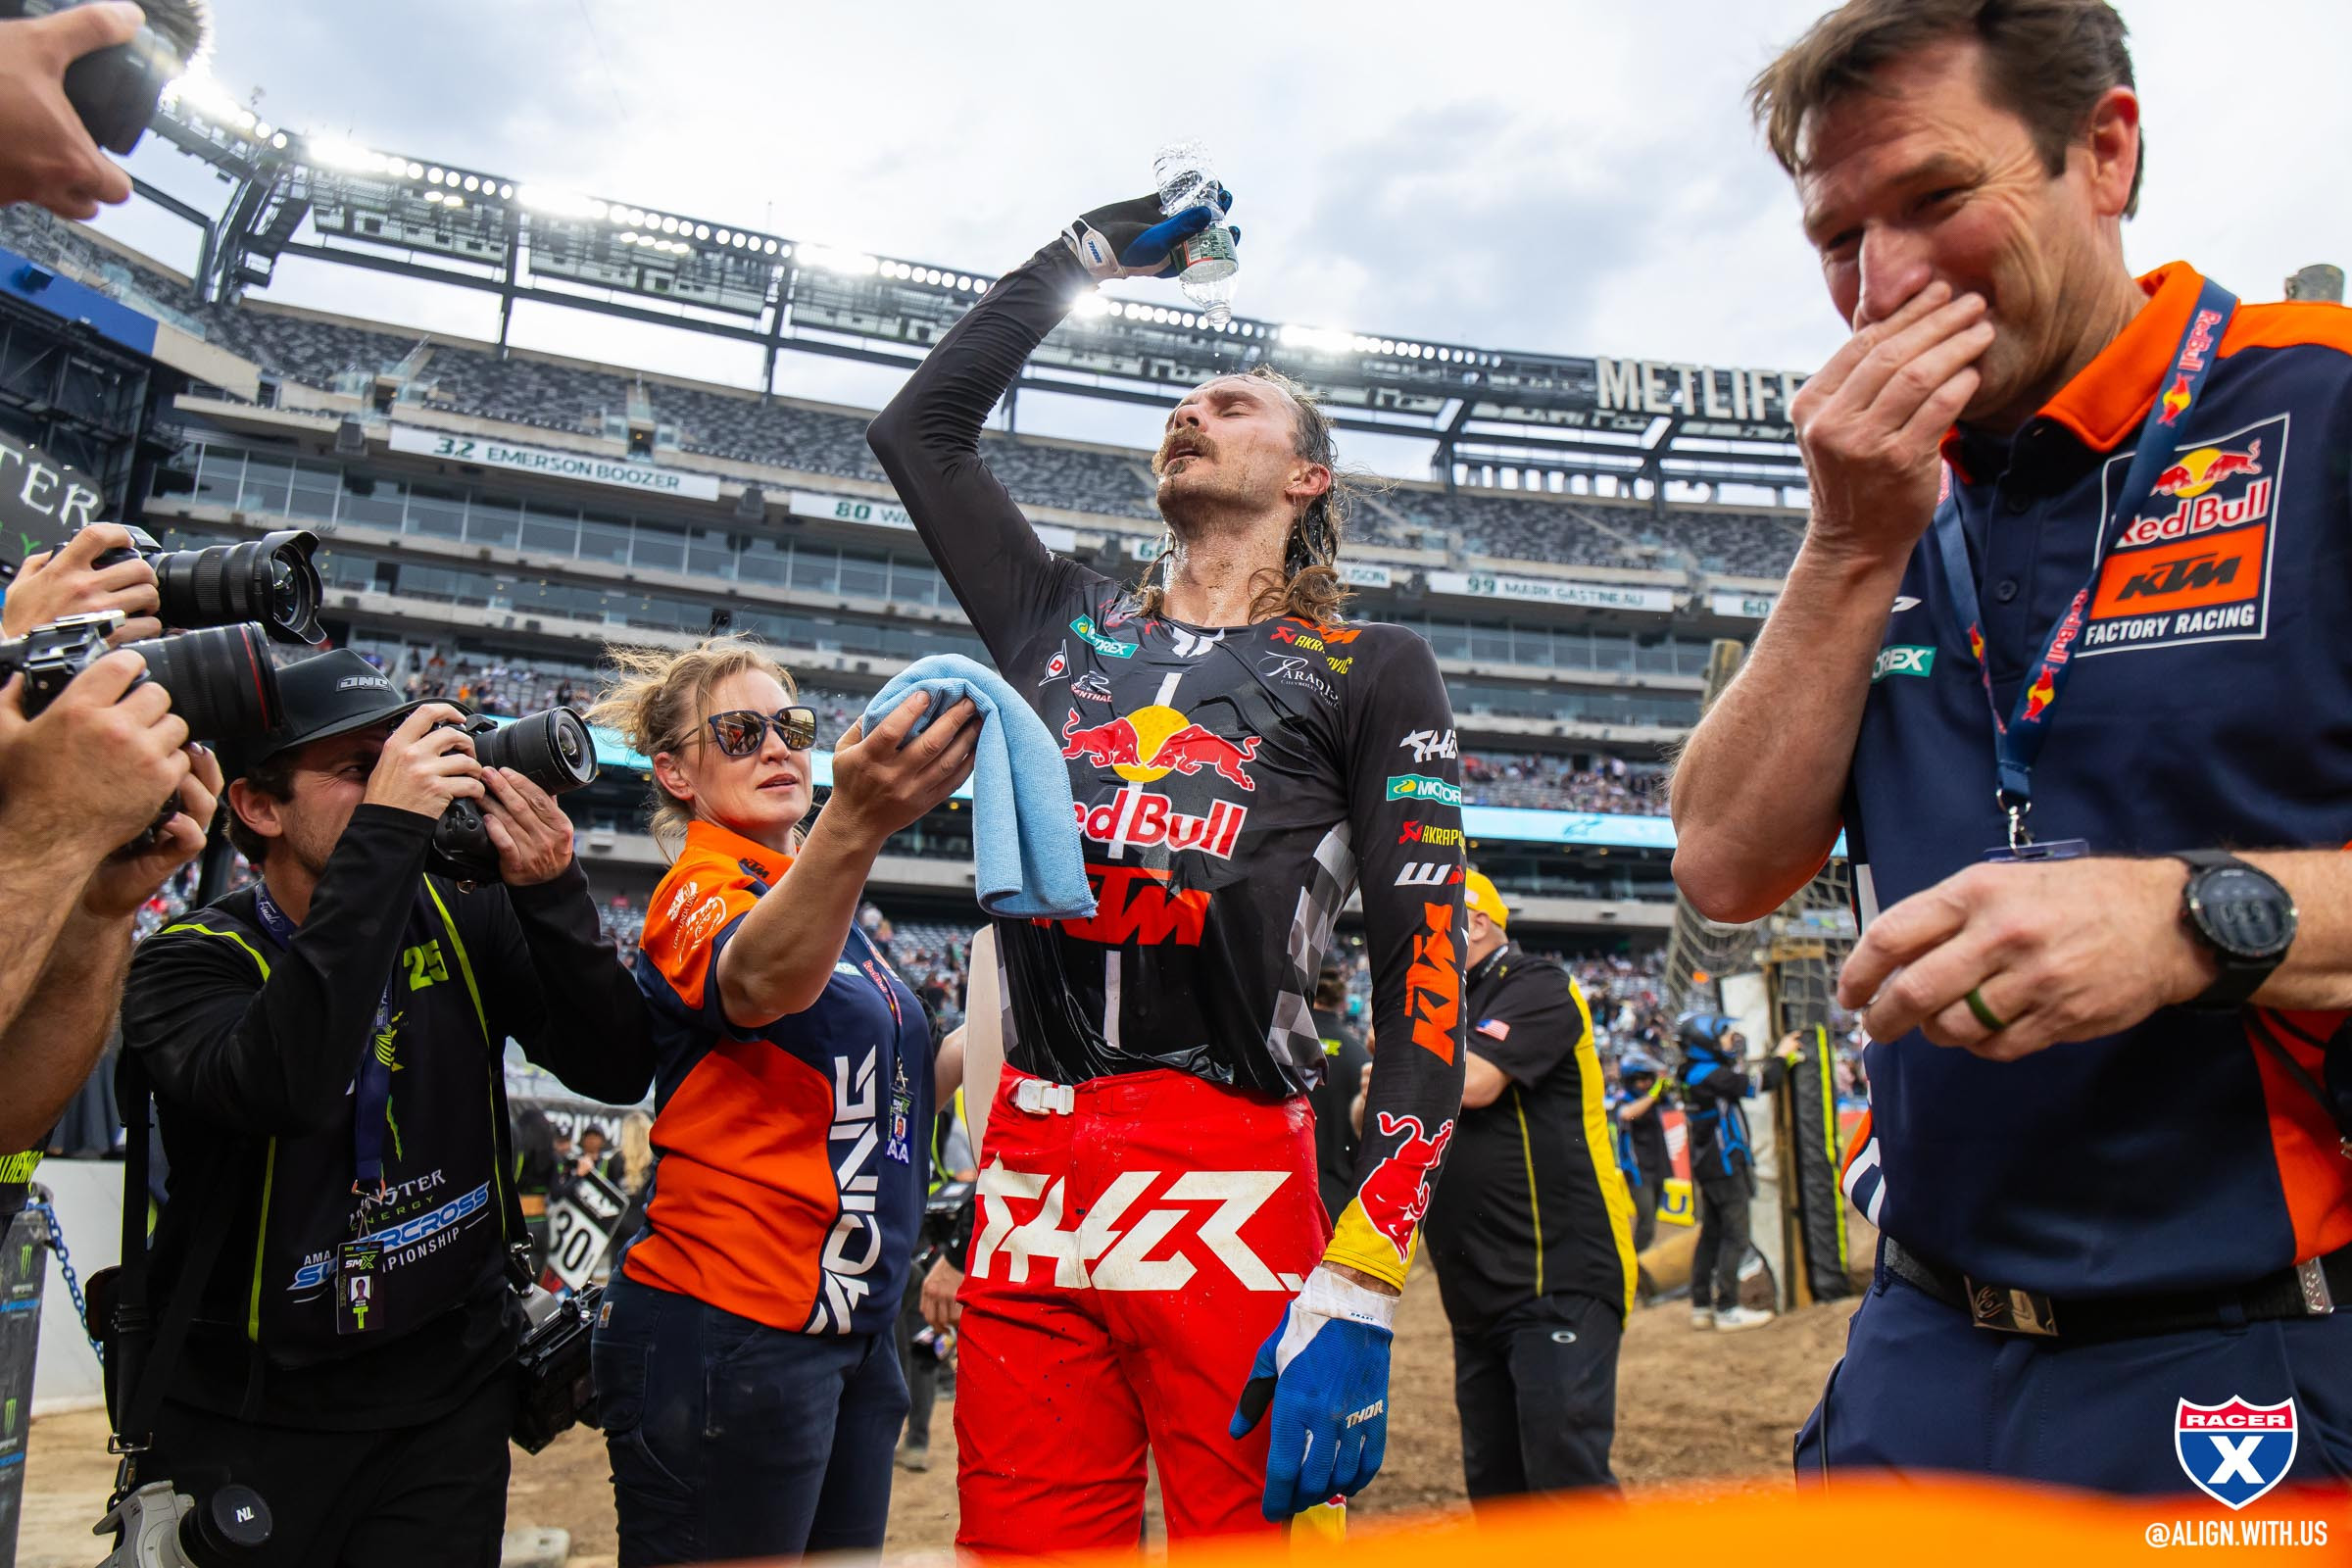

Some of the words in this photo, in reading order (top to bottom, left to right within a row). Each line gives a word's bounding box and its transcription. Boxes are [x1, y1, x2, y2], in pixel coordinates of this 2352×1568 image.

[1087, 239, 1104, 265] THOR
[433, 436, 475, 459] 32
[487, 446, 592, 476] EMERSON
[597, 465, 680, 490] BOOZER
[834, 501, 871, 520] 80
[2189, 476, 2272, 534] Bull
[1467, 571, 1495, 596] 99
[1504, 581, 1555, 602] MARK
[1558, 586, 1644, 609] GASTINEAU
[2115, 552, 2243, 602] KTM
[2084, 616, 2171, 647] FACTORY
[2174, 604, 2255, 635] RACING
[1129, 790, 1248, 860] Bull
[738, 858, 770, 879] KTM
[403, 939, 449, 992] 25
[1403, 903, 1458, 1066] KTM
[886, 1138, 909, 1164] AA
[304, 1250, 331, 1266] AMA
[344, 1254, 375, 1270] SMX
[1345, 1397, 1384, 1429] THOR
